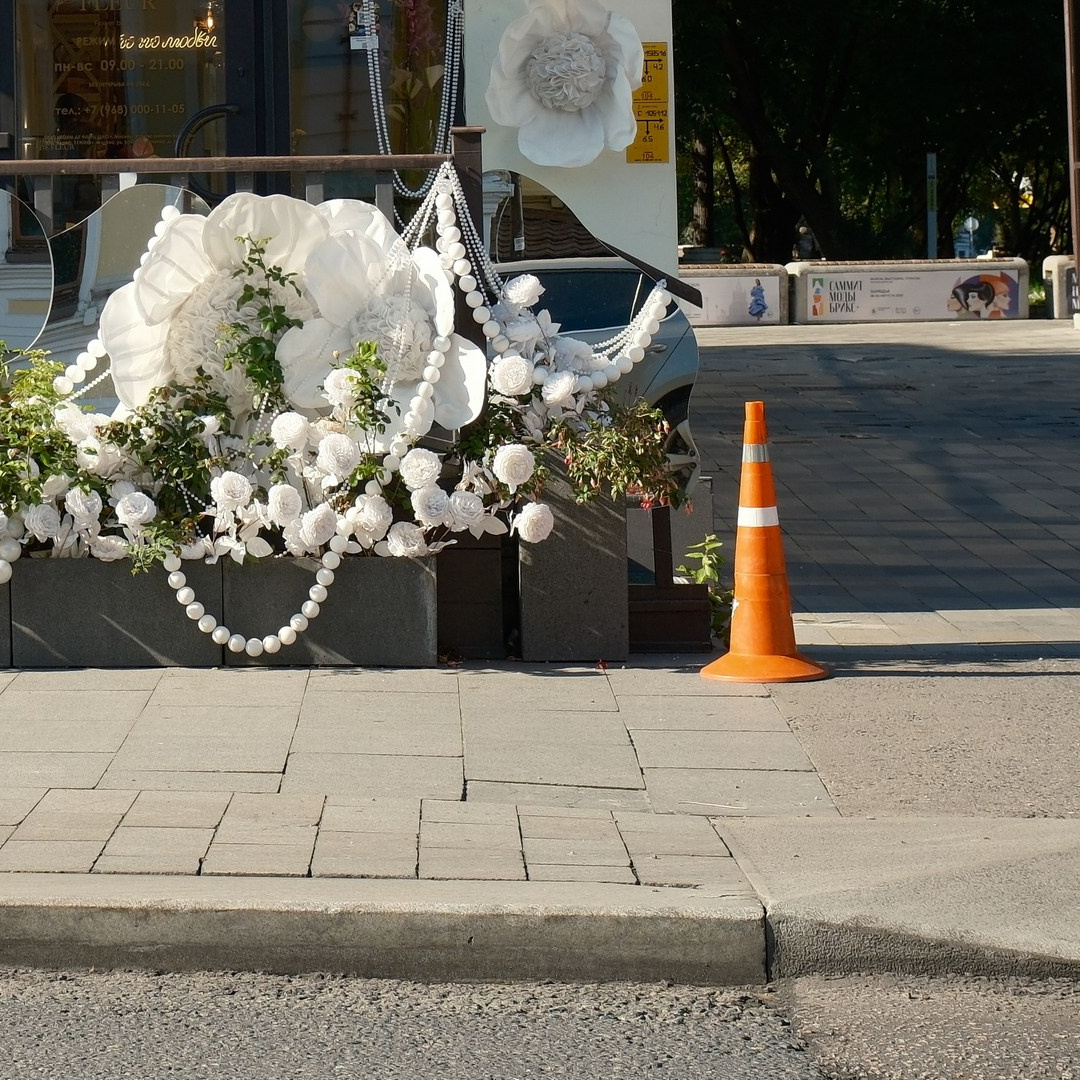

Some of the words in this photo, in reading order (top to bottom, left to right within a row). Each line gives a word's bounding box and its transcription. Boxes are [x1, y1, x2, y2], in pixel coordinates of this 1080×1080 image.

[100, 59, 136, 71] 09.00
[149, 58, 184, 70] 21.00
[100, 104, 128, 117] (968)
[131, 104, 185, 114] 000-11-05
[829, 280, 863, 291] САММИТ
[829, 291, 856, 302] МОДЫ
